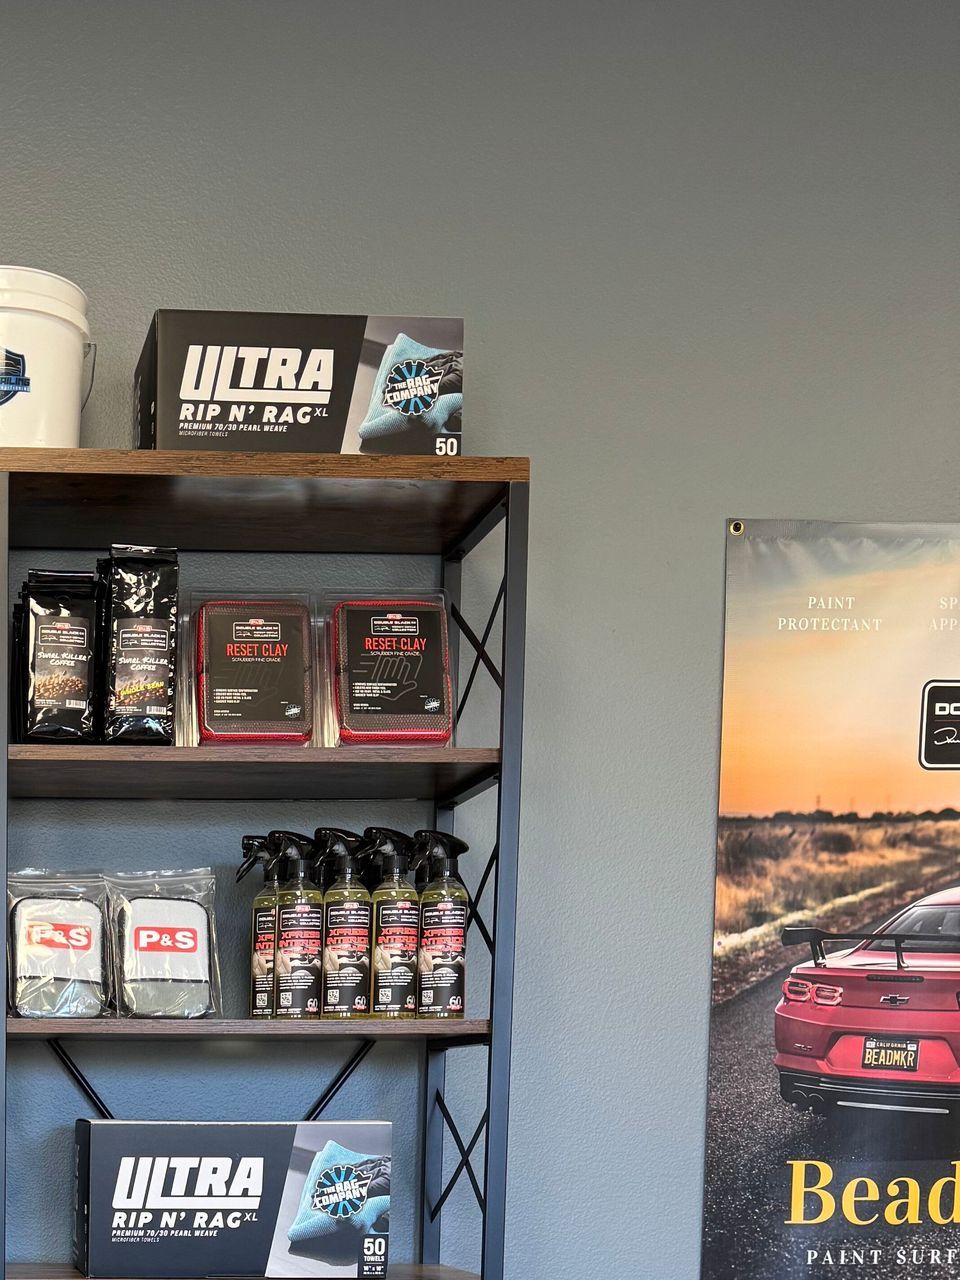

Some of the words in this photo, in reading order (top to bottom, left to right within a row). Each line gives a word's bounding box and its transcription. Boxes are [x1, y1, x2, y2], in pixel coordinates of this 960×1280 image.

[179, 345, 335, 404] ULTRA
[395, 380, 407, 390] THE
[406, 374, 431, 390] RAG
[386, 383, 440, 404] COMPANY
[179, 403, 223, 421] RIP
[229, 404, 254, 423] N'
[262, 405, 312, 424] RAG
[314, 406, 329, 417] XL
[179, 422, 213, 430] PREMIUM
[214, 423, 238, 431] 70/30
[238, 423, 261, 432] PEARL
[263, 424, 288, 433] WEAVE
[435, 437, 458, 456] 50
[808, 597, 856, 609] PAINT
[777, 617, 882, 631] PROTECTANT
[226, 643, 259, 656] RESET
[262, 643, 289, 656] CLAY
[365, 637, 398, 650] RESET
[400, 638, 427, 651] CLAY
[38, 651, 60, 659] SWIRL
[61, 652, 86, 661] KILLER
[50, 659, 75, 667] COFFEE
[119, 656, 141, 664] SWIRL
[143, 656, 168, 665] KILLER
[31, 925, 90, 947] P&S
[139, 929, 195, 949] P&S
[864, 1048, 916, 1067] BEADMKR
[112, 1156, 265, 1209] ULTRA
[324, 1185, 336, 1195] THE
[335, 1179, 360, 1193] RAG
[315, 1187, 368, 1207] COMPANY
[784, 1160, 960, 1226] Bead
[112, 1212, 153, 1228] RIP
[160, 1212, 186, 1228] N'
[193, 1212, 242, 1228] RAG
[244, 1212, 258, 1221] XL
[112, 1229, 145, 1237] PREMIUM
[146, 1229, 168, 1237] 70/30
[168, 1229, 192, 1237] PEARL
[194, 1229, 218, 1237] WEAVE
[363, 1238, 385, 1255] 50
[806, 1250, 882, 1265] PAINT
